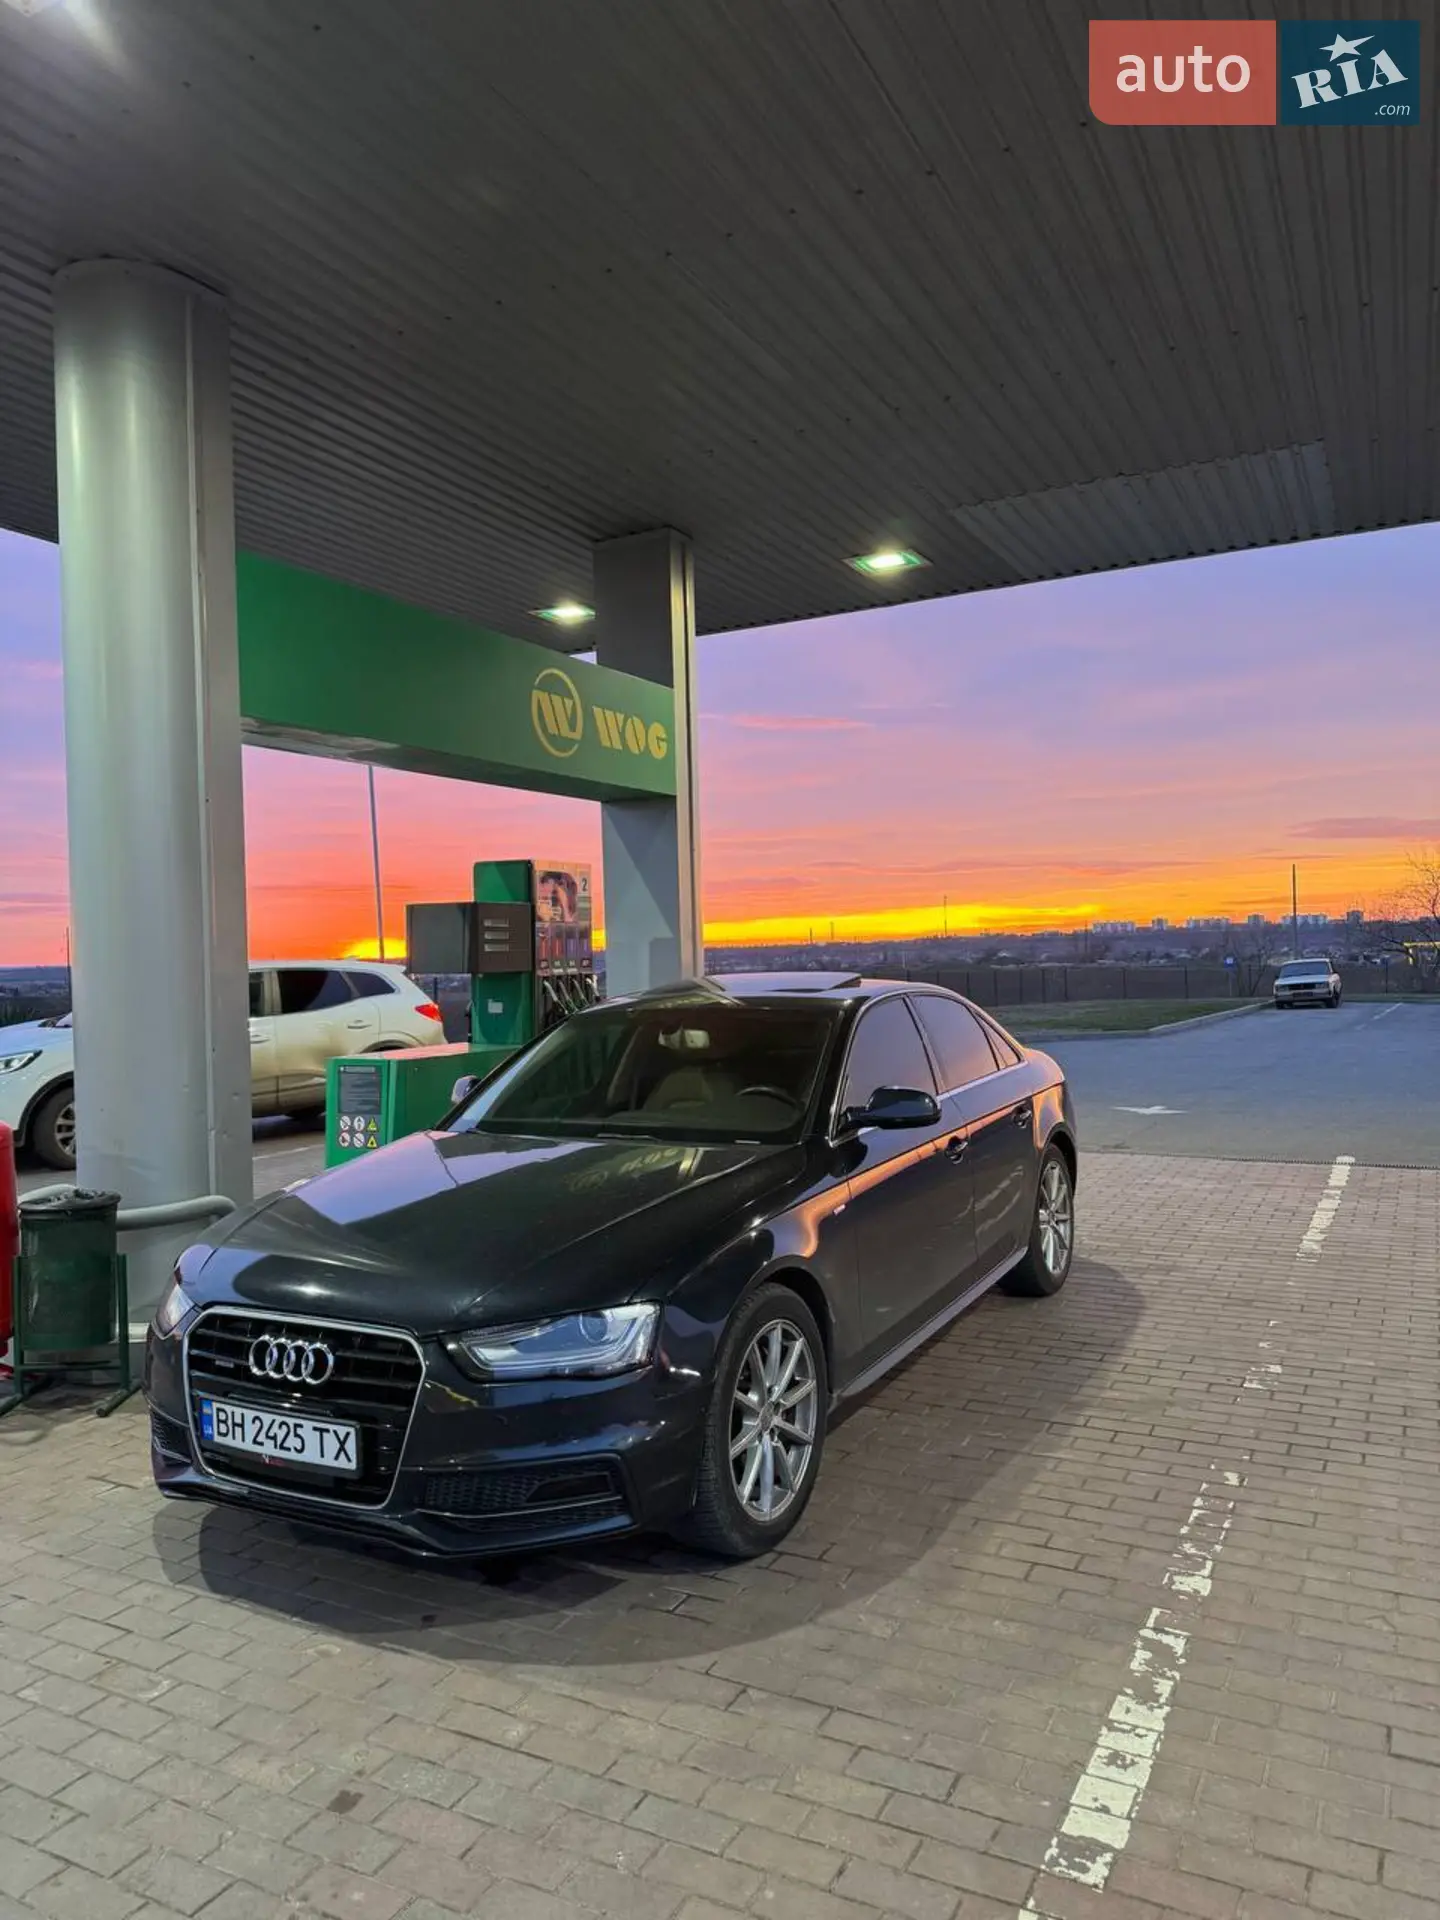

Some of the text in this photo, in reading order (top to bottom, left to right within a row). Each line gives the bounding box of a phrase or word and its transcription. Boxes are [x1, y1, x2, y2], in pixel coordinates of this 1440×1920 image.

[592, 705, 668, 760] WOG
[582, 878, 588, 892] 2
[215, 1407, 353, 1463] BH 2425 TX
